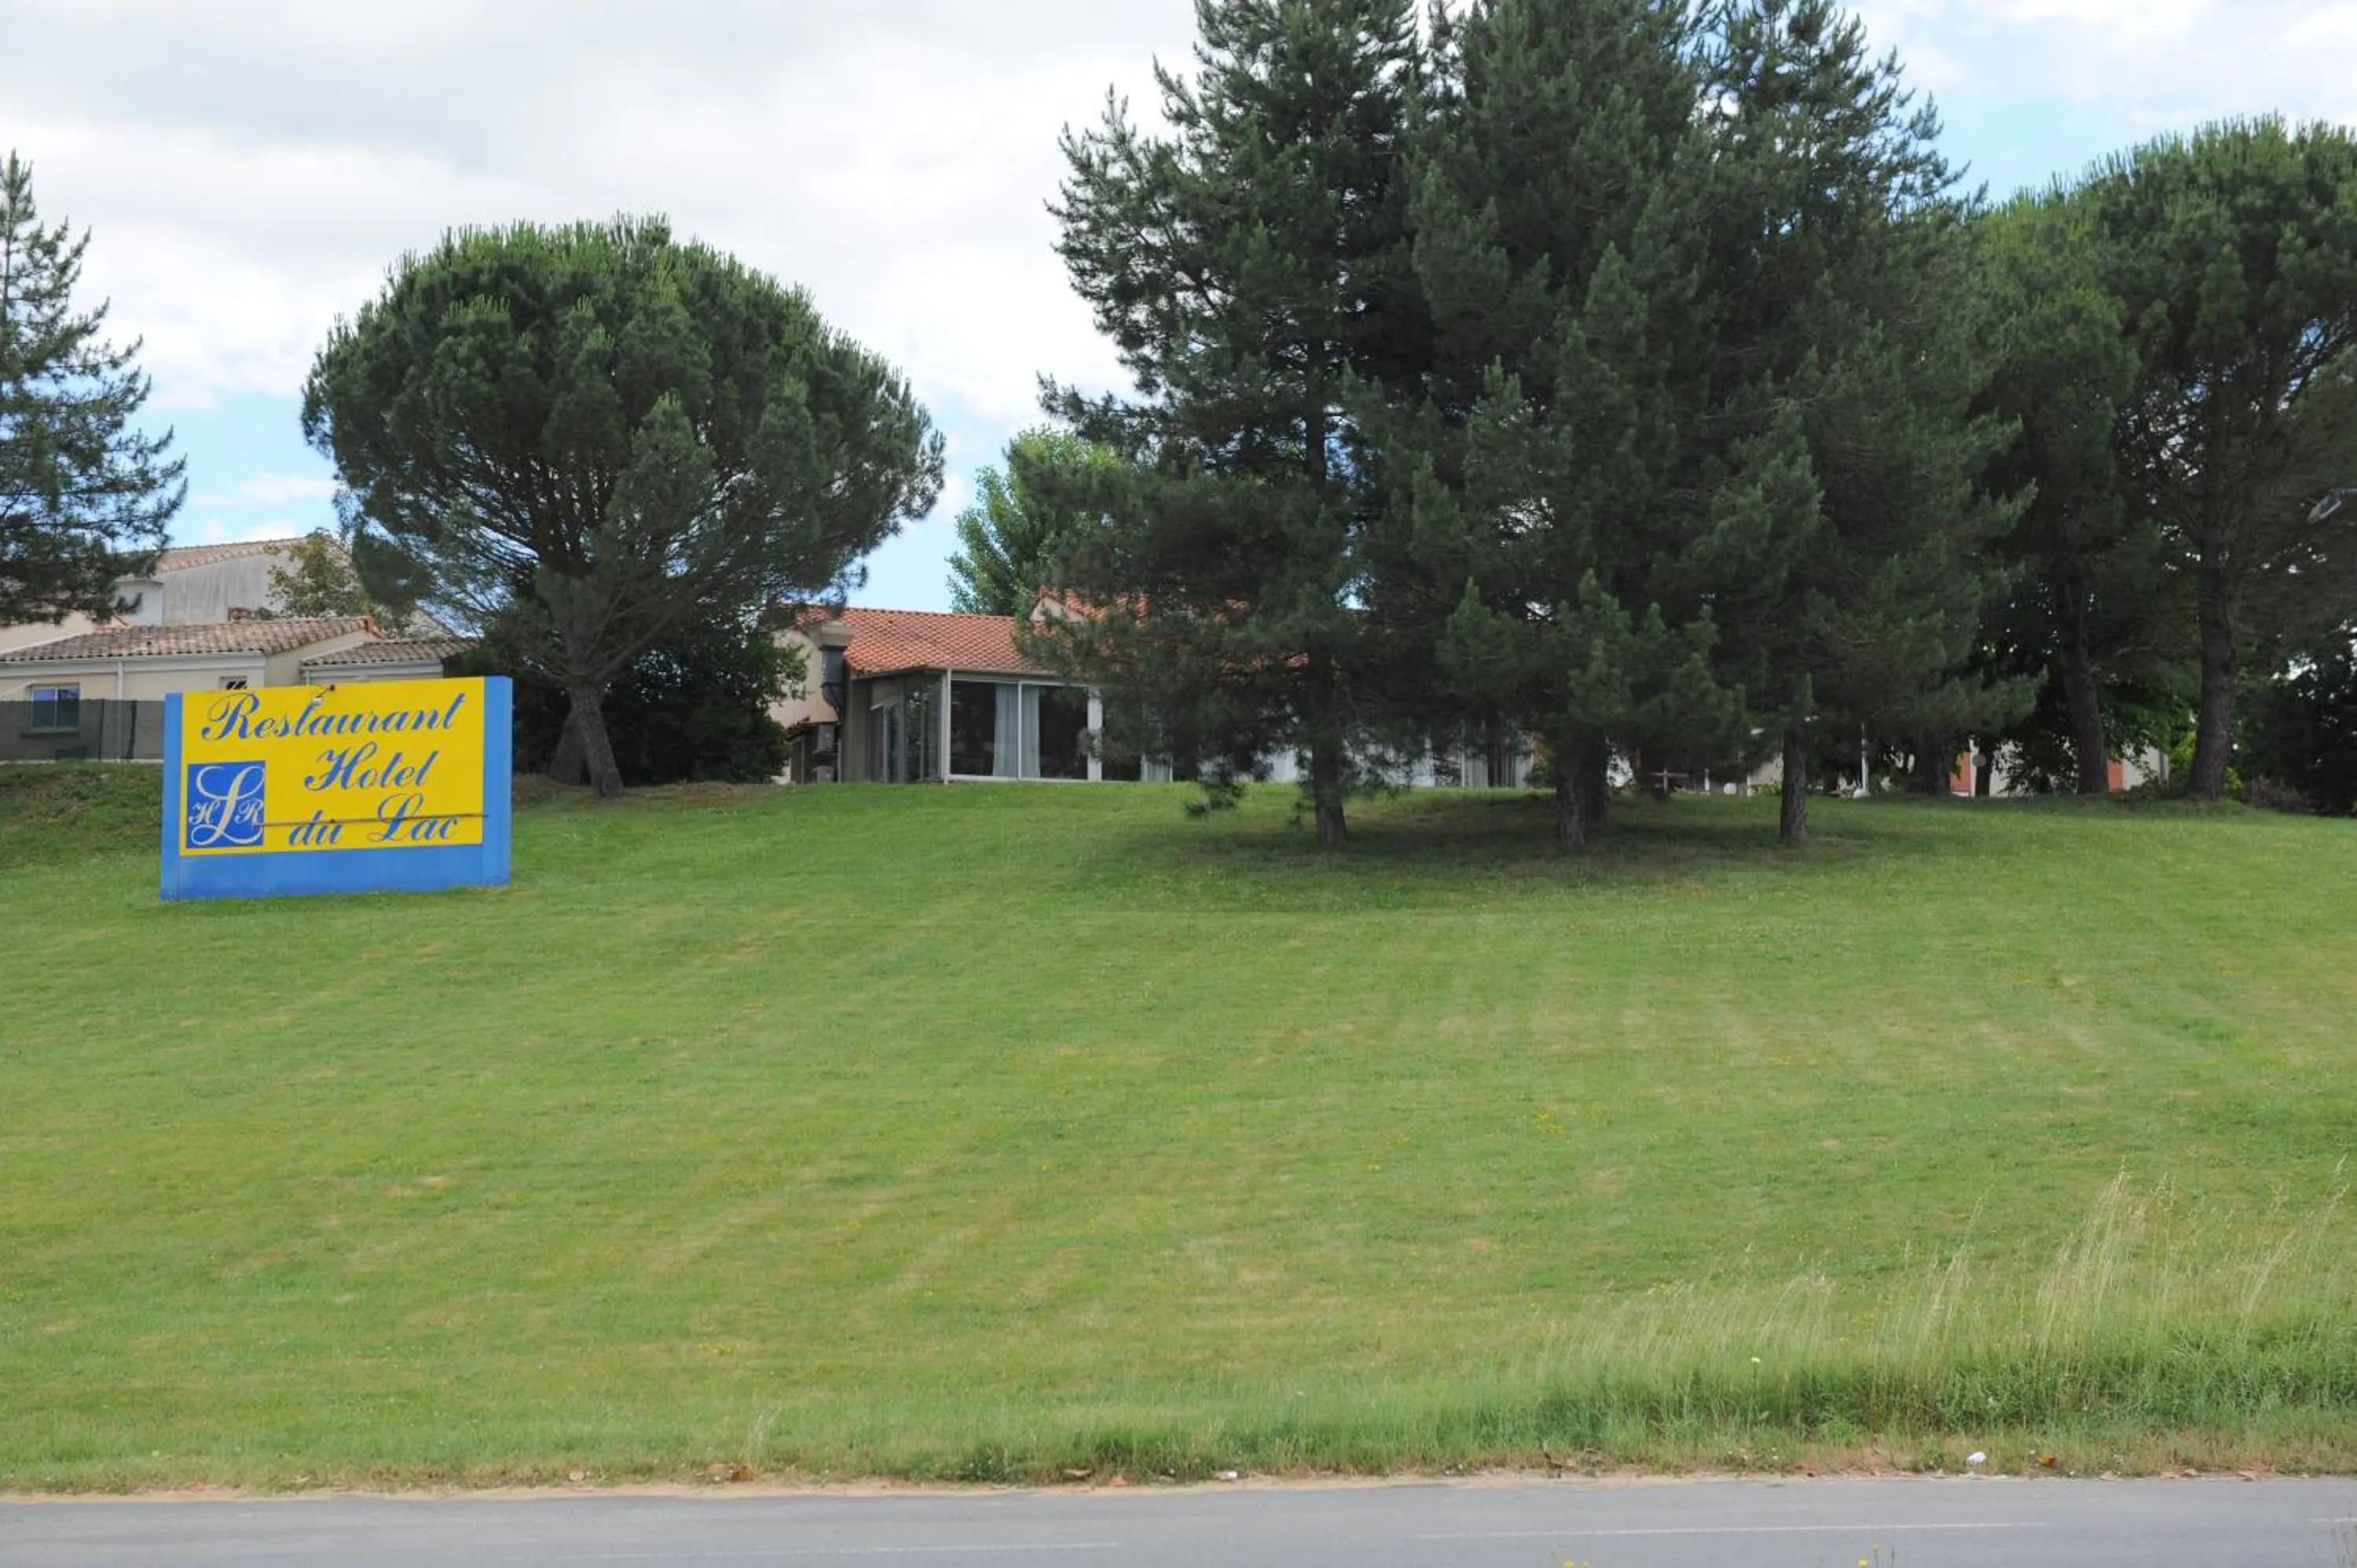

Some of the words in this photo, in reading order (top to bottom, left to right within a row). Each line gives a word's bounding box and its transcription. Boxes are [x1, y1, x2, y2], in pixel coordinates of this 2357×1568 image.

[201, 692, 466, 742] Restaurant
[304, 741, 440, 792] Hotel
[288, 810, 345, 847] du
[366, 793, 460, 842] Lac
